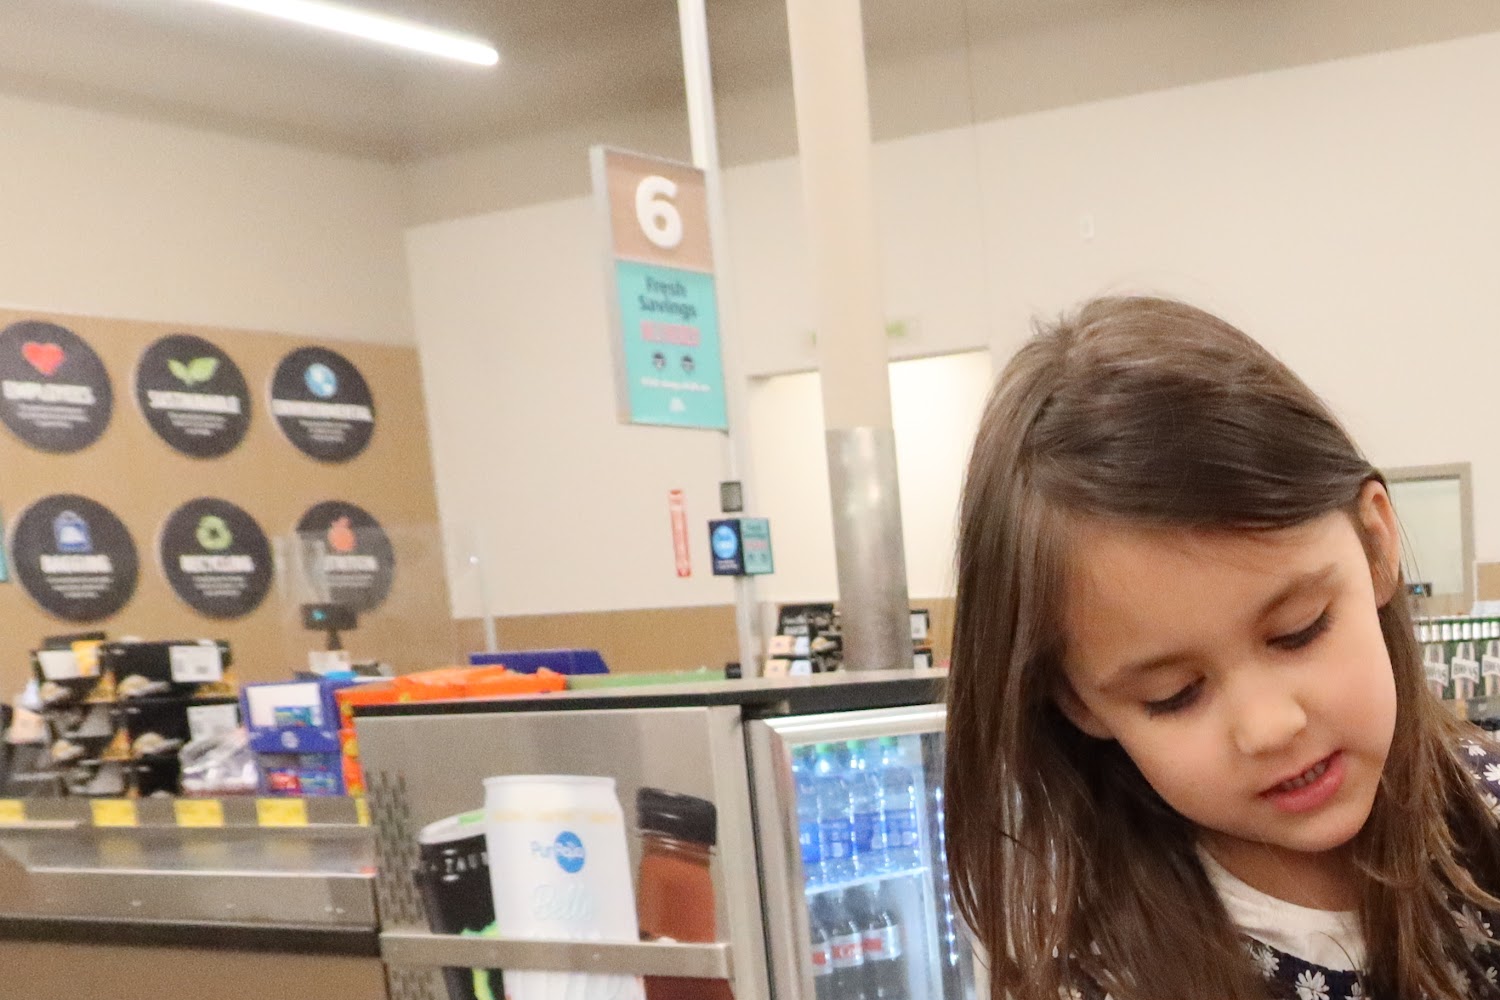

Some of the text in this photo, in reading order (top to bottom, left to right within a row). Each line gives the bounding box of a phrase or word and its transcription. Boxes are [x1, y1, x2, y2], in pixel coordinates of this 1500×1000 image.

[634, 175, 684, 250] 6
[645, 275, 688, 297] Fresh
[637, 295, 698, 319] Savings
